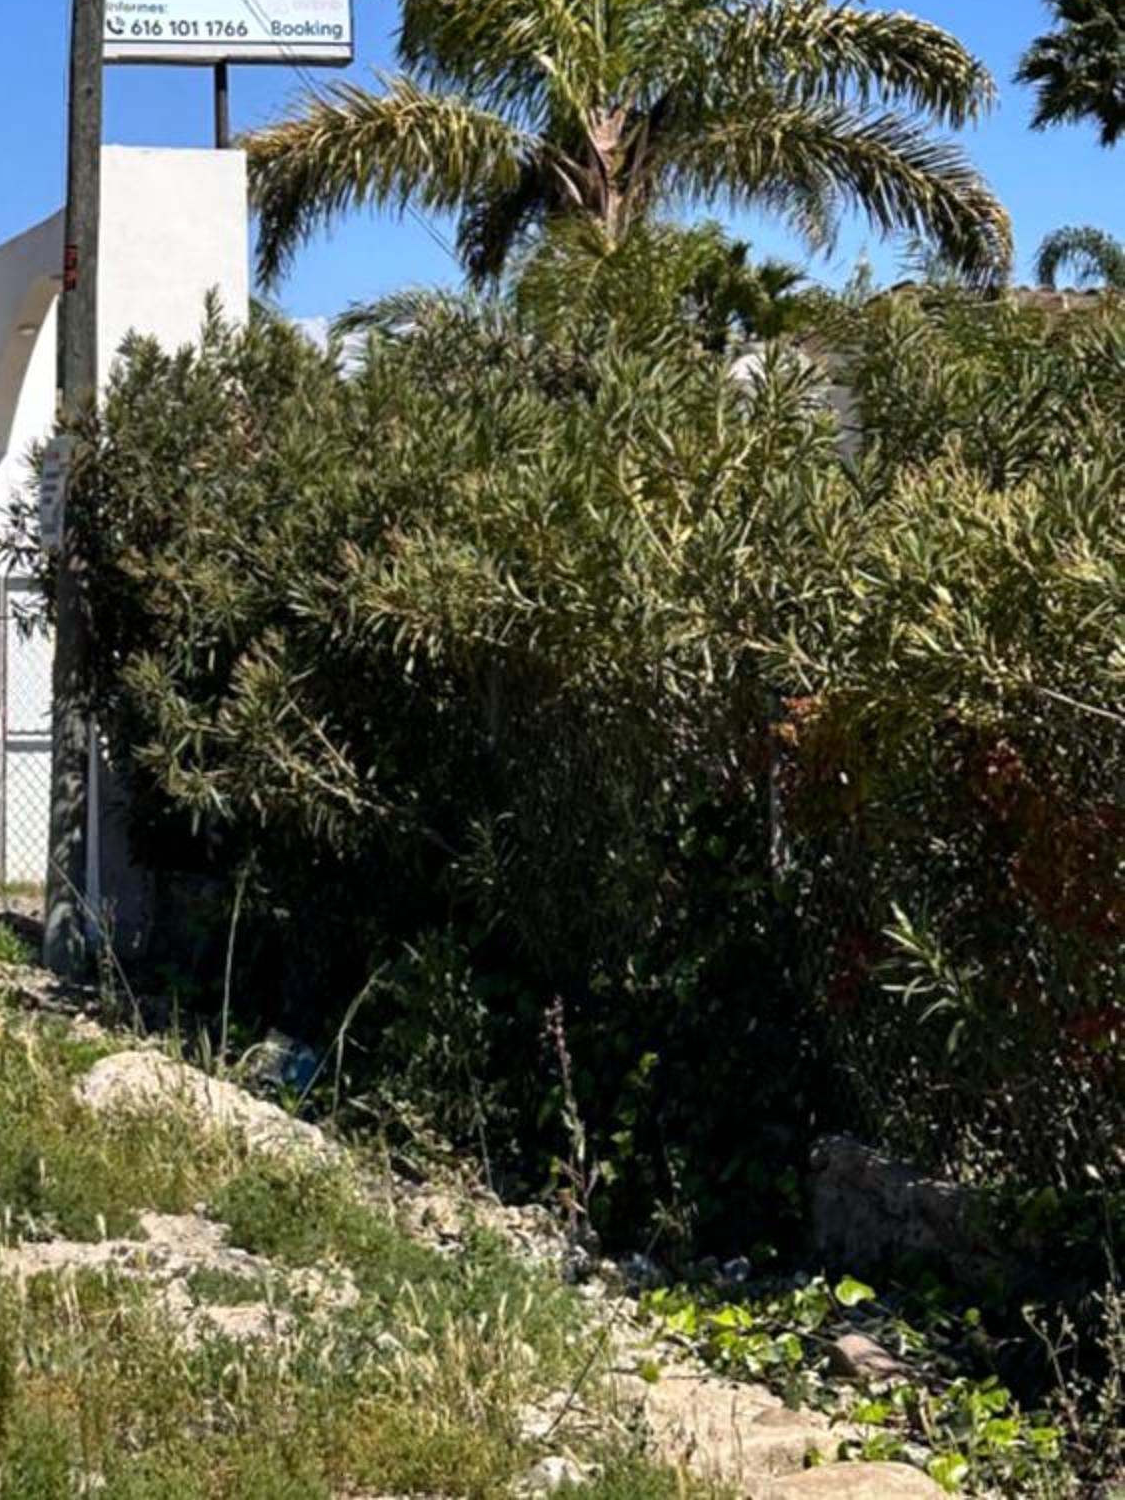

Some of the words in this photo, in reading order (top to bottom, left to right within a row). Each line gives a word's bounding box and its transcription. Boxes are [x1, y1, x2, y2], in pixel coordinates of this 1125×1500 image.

[130, 19, 163, 36] 616
[169, 20, 199, 36] 101
[205, 20, 249, 37] 1766
[270, 20, 343, 40] Booking
